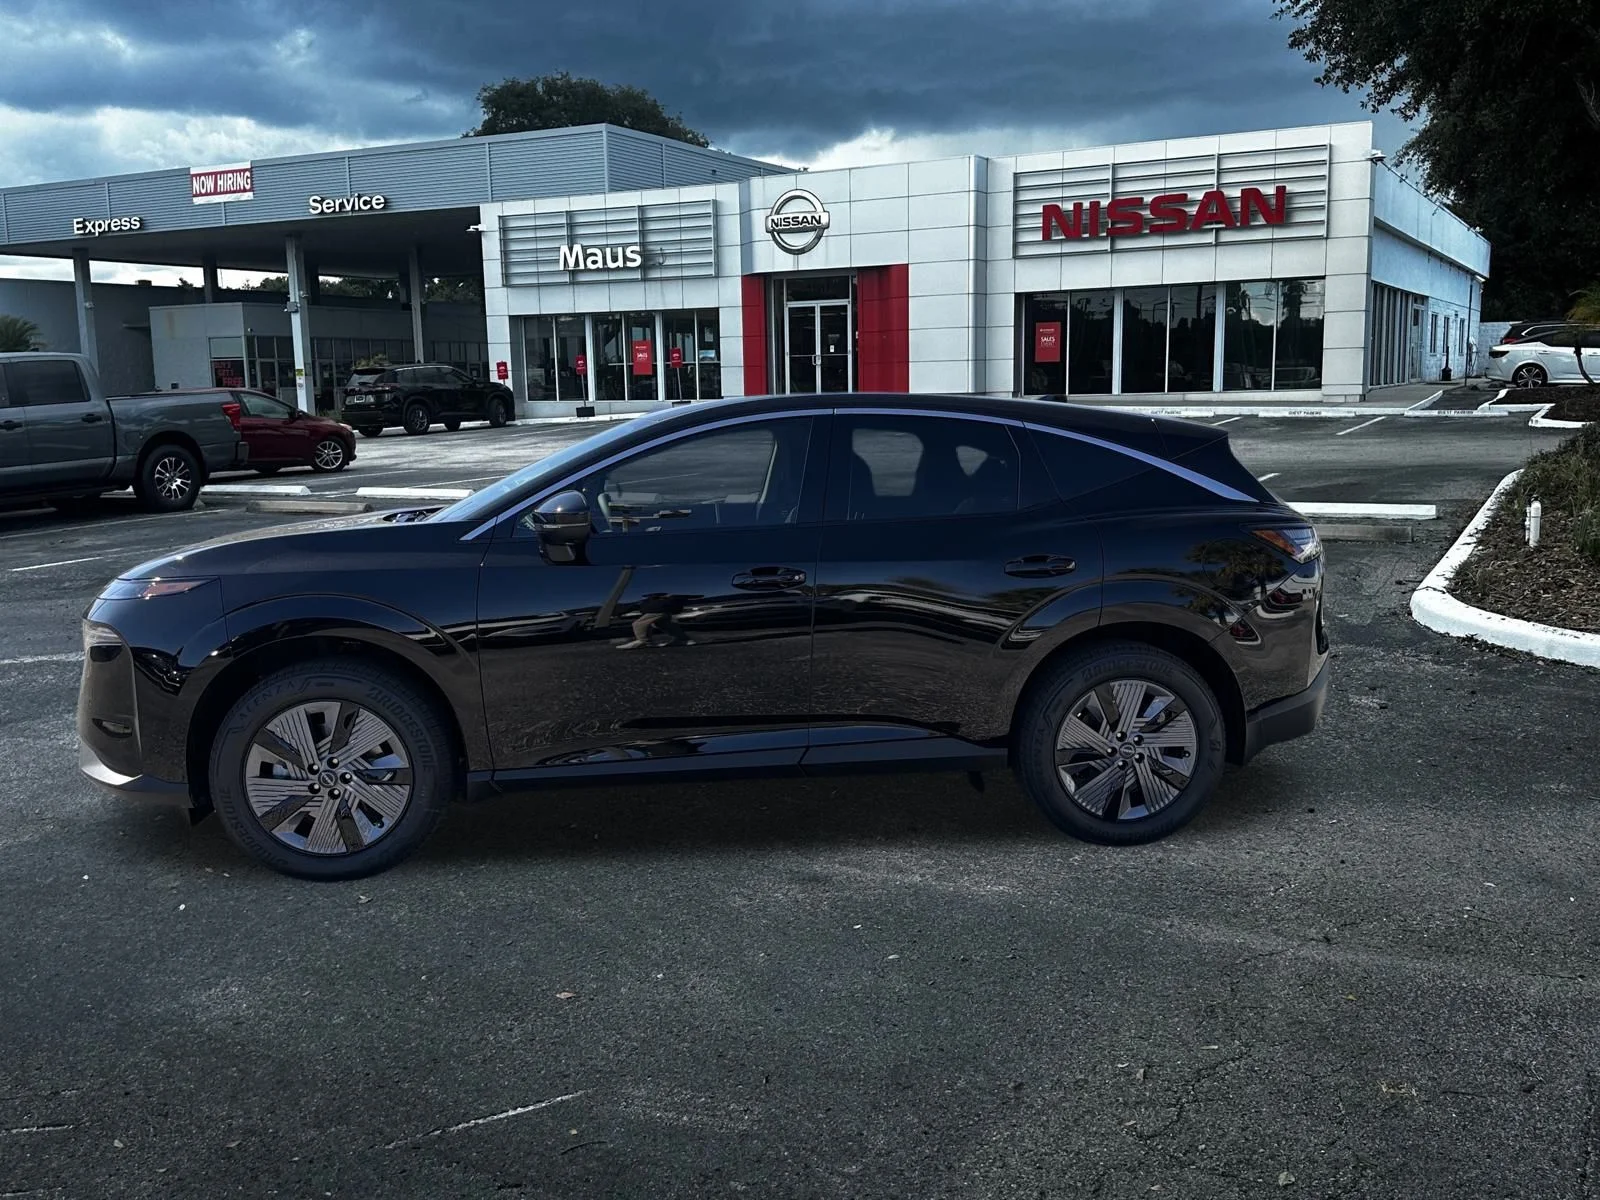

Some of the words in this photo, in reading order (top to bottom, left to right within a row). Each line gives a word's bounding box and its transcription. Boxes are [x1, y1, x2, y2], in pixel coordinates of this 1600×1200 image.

[192, 175, 215, 195] NOW
[217, 171, 251, 192] HIRING
[309, 192, 385, 214] Service
[1041, 185, 1287, 241] NISSAN
[73, 216, 141, 236] Express
[769, 214, 822, 230] NISSAN
[559, 243, 642, 271] Maus
[365, 686, 435, 773] BRIDGESTONE
